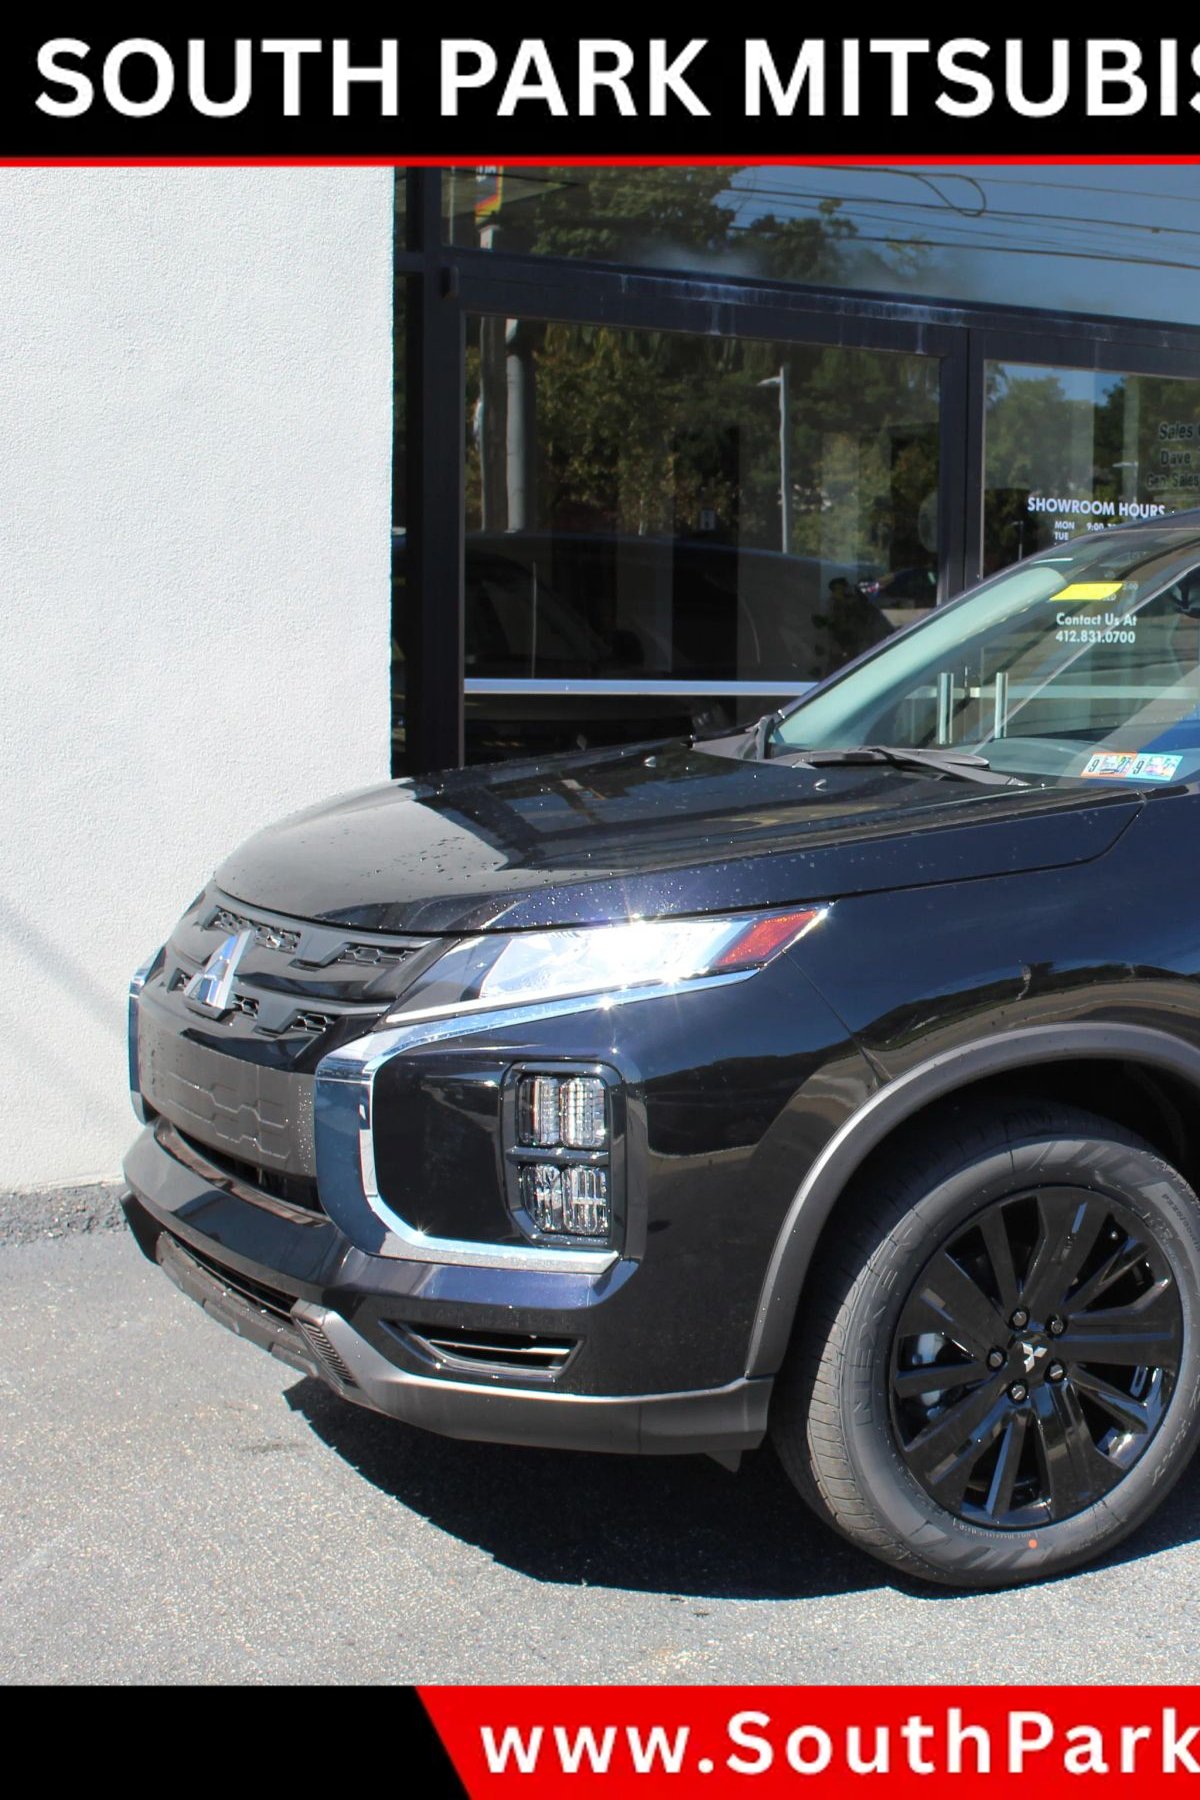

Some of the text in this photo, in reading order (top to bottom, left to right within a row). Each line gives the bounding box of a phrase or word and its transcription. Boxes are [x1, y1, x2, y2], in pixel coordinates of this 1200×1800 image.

[1159, 422, 1193, 440] Sales
[1161, 450, 1191, 465] Dave
[1027, 497, 1166, 518] SHOWROOM HOURS
[1054, 520, 1075, 530] MON
[1054, 531, 1069, 541] TUE
[1056, 612, 1137, 627] Contact Us At
[1055, 630, 1136, 644] 412.831.0700
